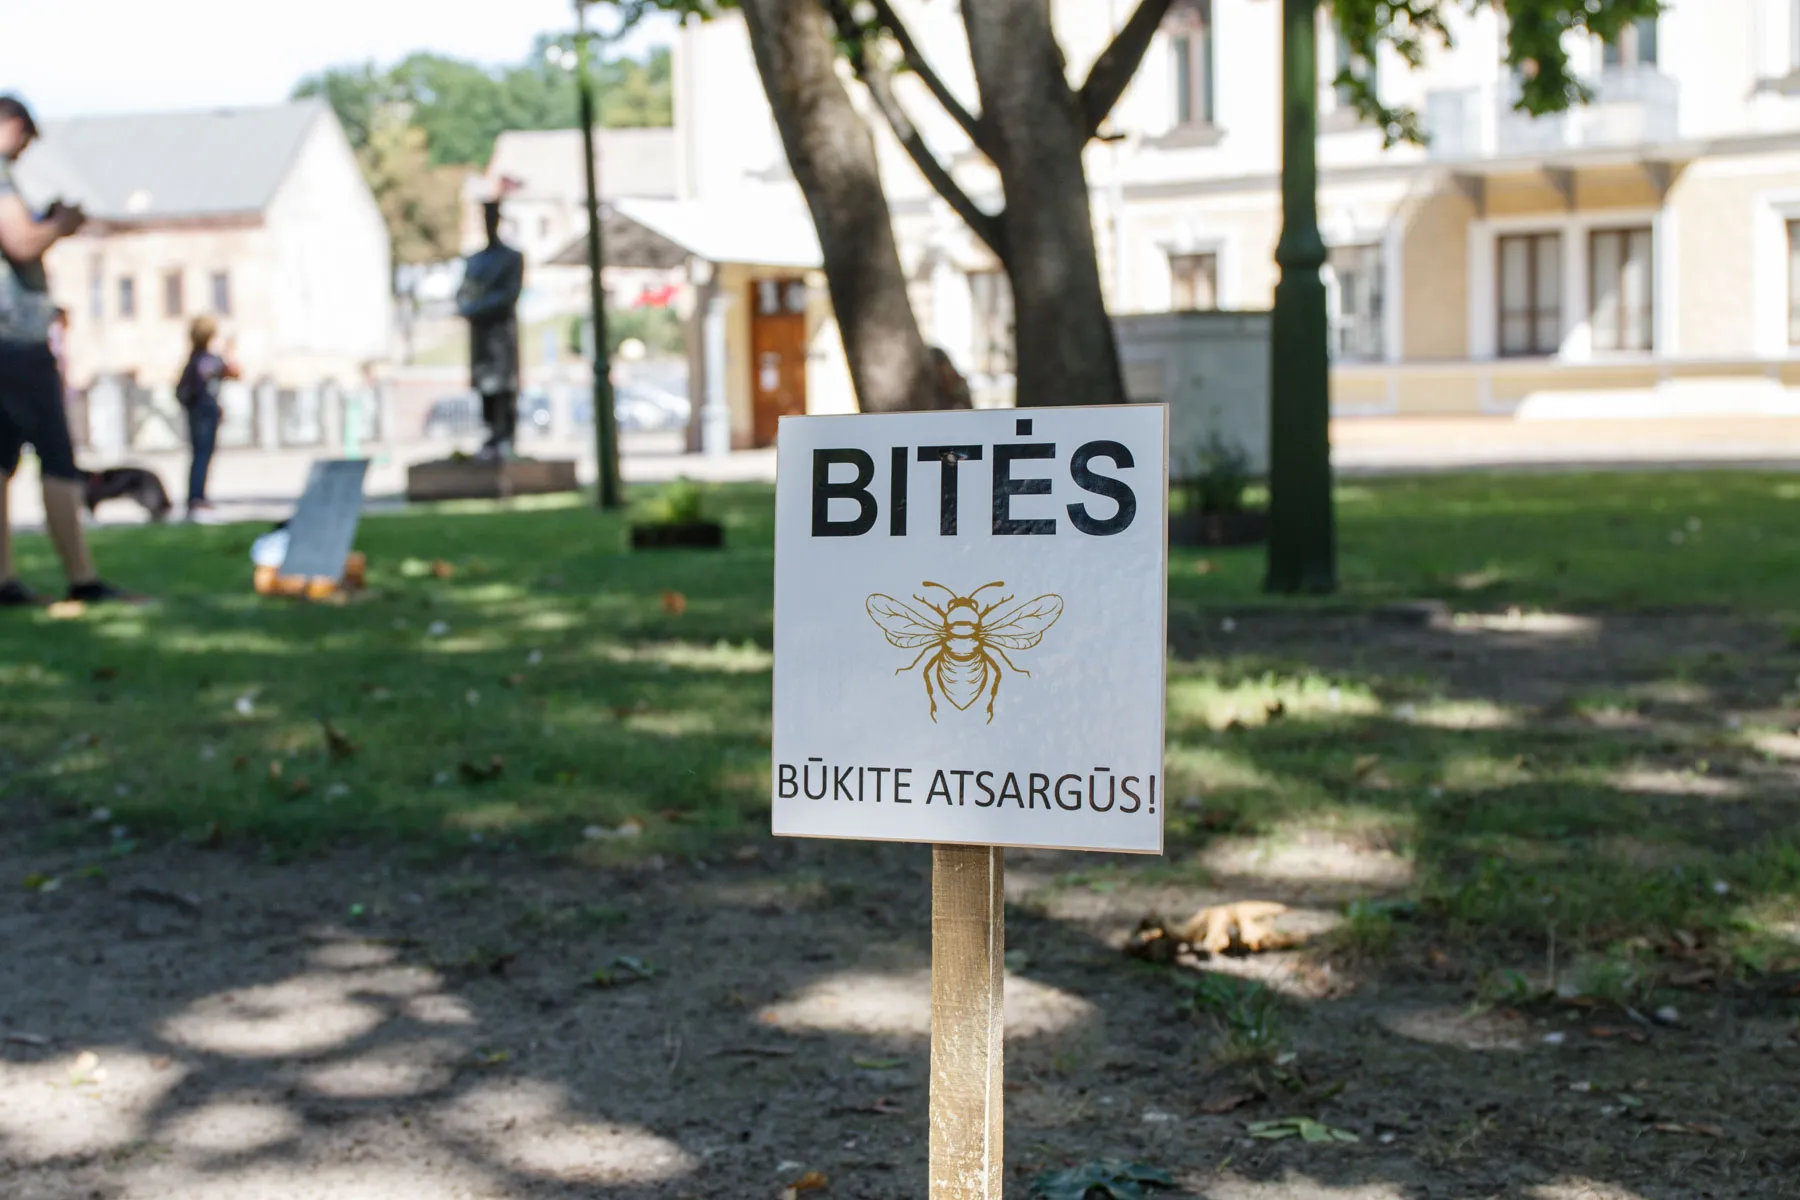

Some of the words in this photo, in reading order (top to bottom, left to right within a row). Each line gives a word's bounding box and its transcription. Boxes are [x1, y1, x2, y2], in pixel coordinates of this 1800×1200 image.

[811, 418, 1137, 538] BITĖS
[778, 756, 913, 804] BŪKITE
[925, 766, 1156, 815] ATSARGŪS!
